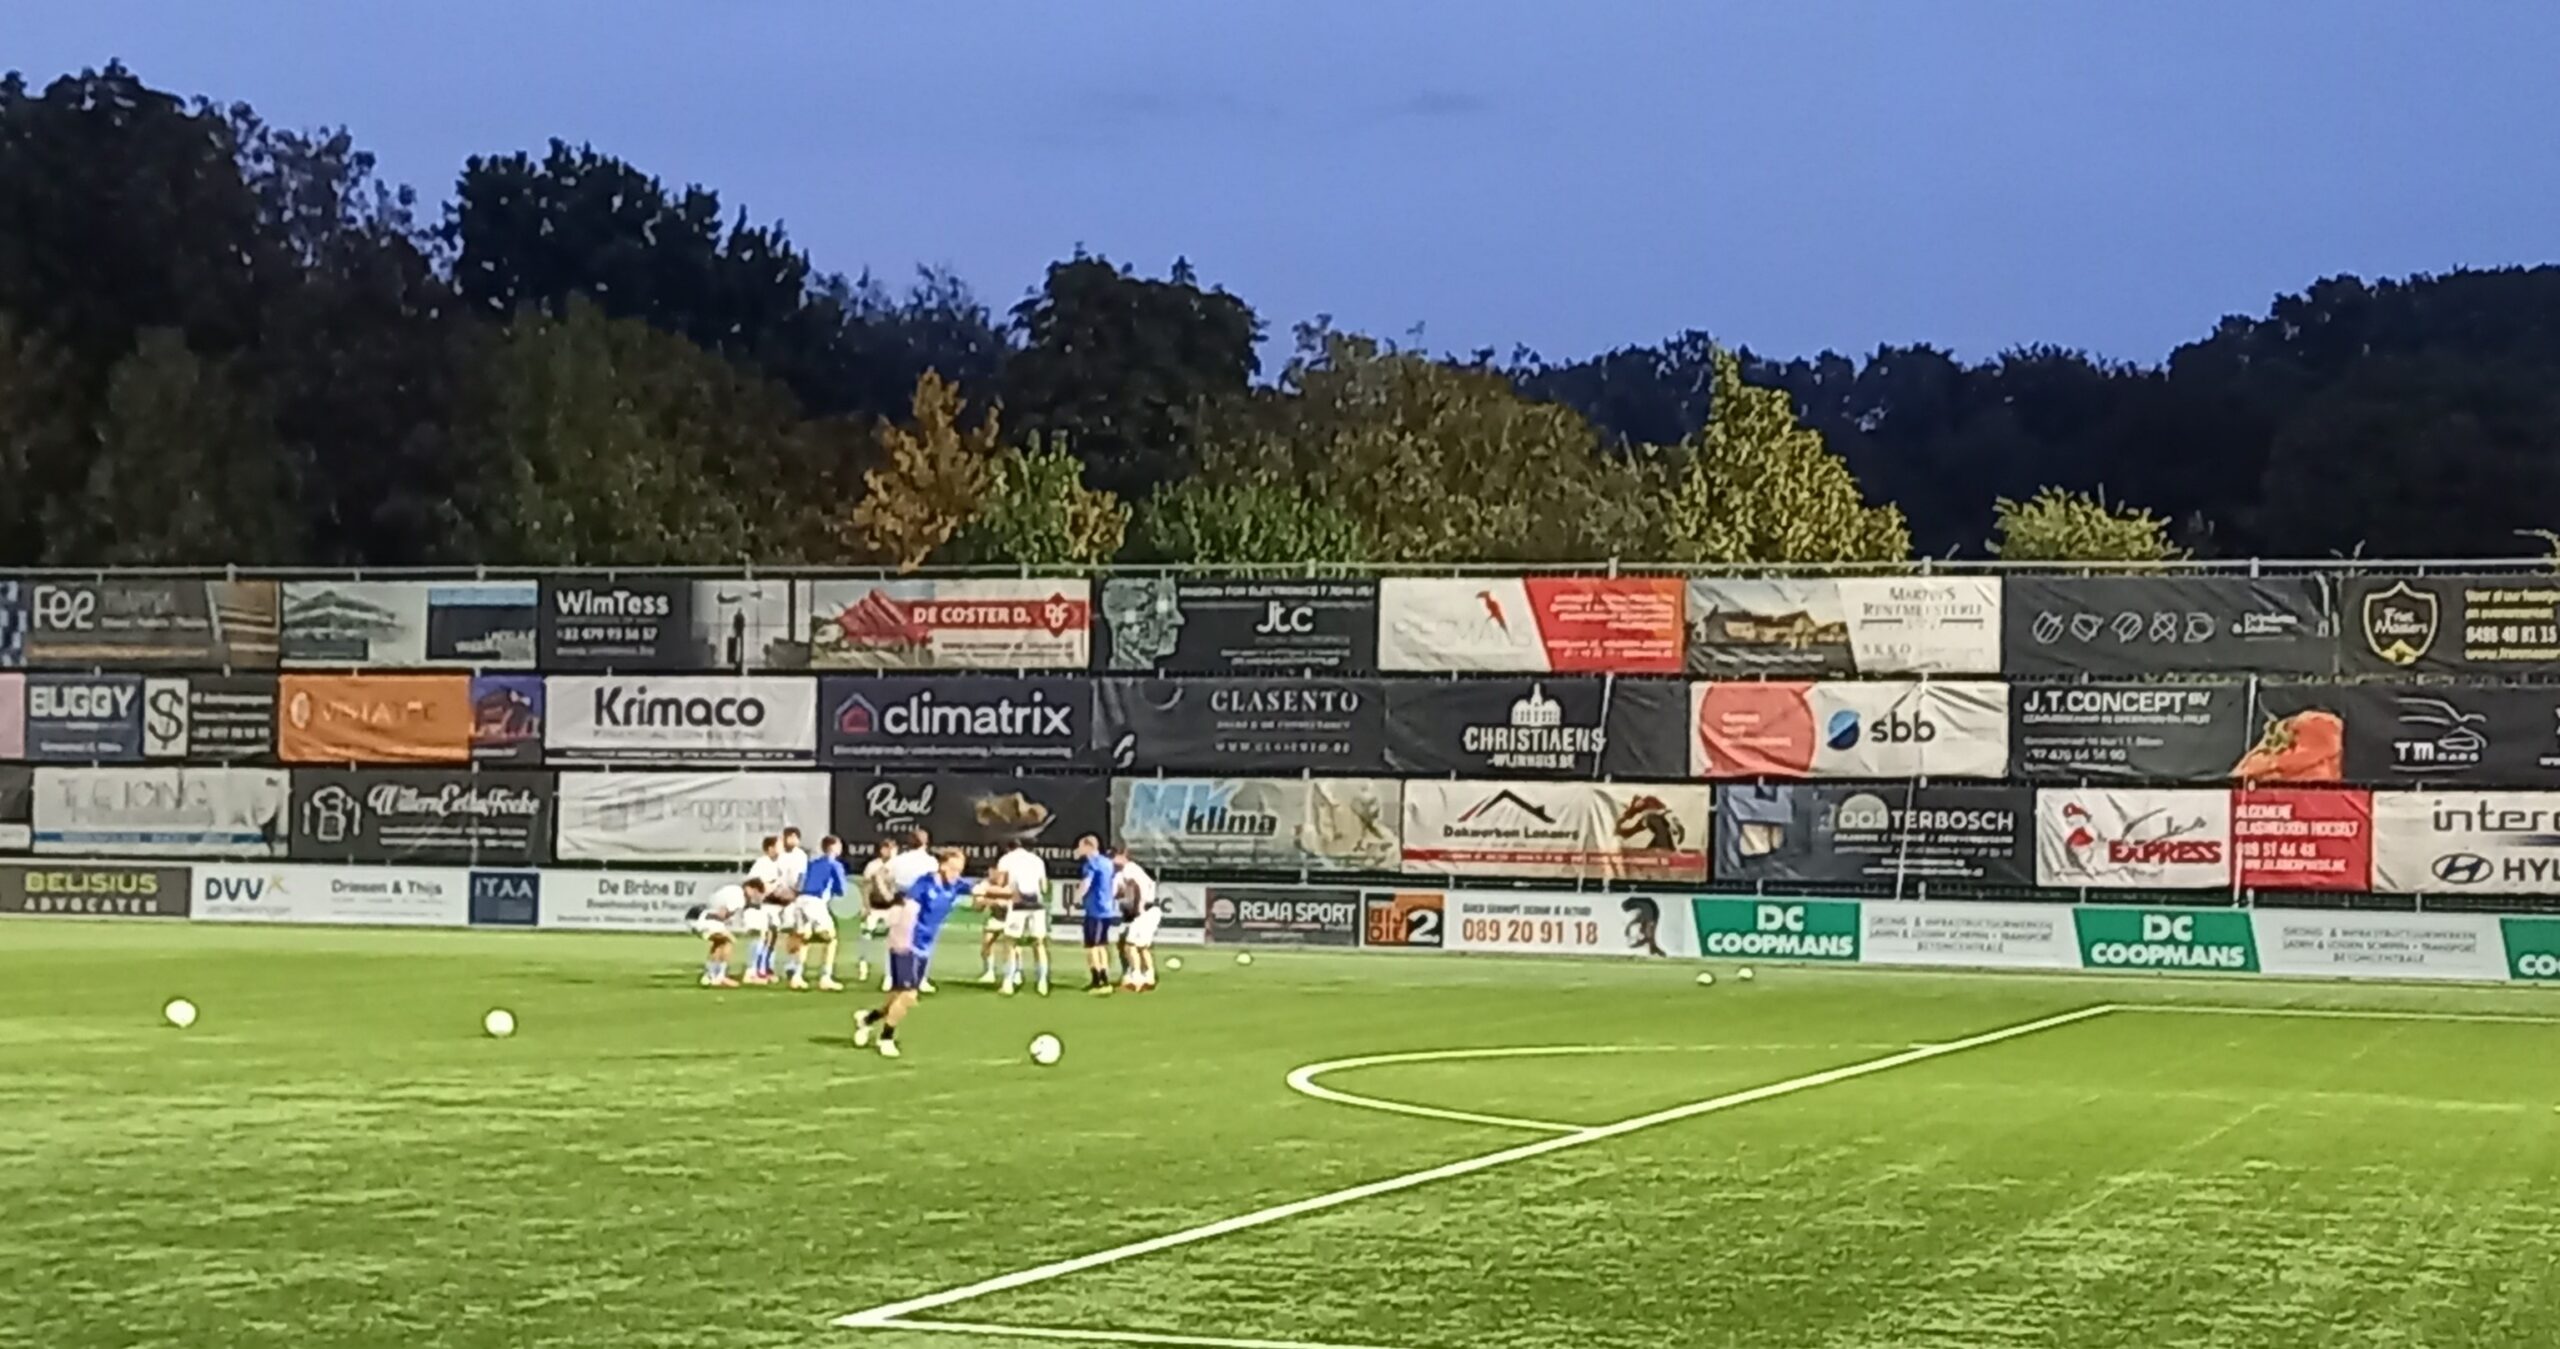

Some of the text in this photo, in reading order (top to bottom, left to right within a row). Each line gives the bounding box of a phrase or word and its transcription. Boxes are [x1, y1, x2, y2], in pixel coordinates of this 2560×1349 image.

[913, 607, 936, 624] DE
[941, 607, 1009, 624] COSTER
[30, 686, 135, 718] BUGGY
[595, 686, 765, 726] Krimaco
[884, 691, 1072, 735] climatrix
[1463, 726, 1606, 752] CHRISTIAENS
[1870, 711, 1936, 743] sbb
[866, 782, 932, 817] Raoul
[1185, 805, 1278, 836] klima
[2434, 800, 2560, 831] inter
[2108, 841, 2222, 864] EXPRESS
[205, 878, 264, 900] DVV
[392, 880, 402, 894] &
[475, 877, 533, 898] ITAA
[598, 880, 619, 895] De
[24, 898, 157, 912] ADVOCATEN
[1239, 901, 1357, 923] REMA SPORT
[1757, 905, 1804, 930] DC
[1407, 908, 1441, 943] 2
[1462, 918, 1598, 945] 089 20 91 18
[2142, 914, 2195, 941] DC
[1707, 932, 1853, 956] COOPMANS
[2091, 943, 2245, 967] COOPMANS
[2518, 953, 2560, 976] CO
